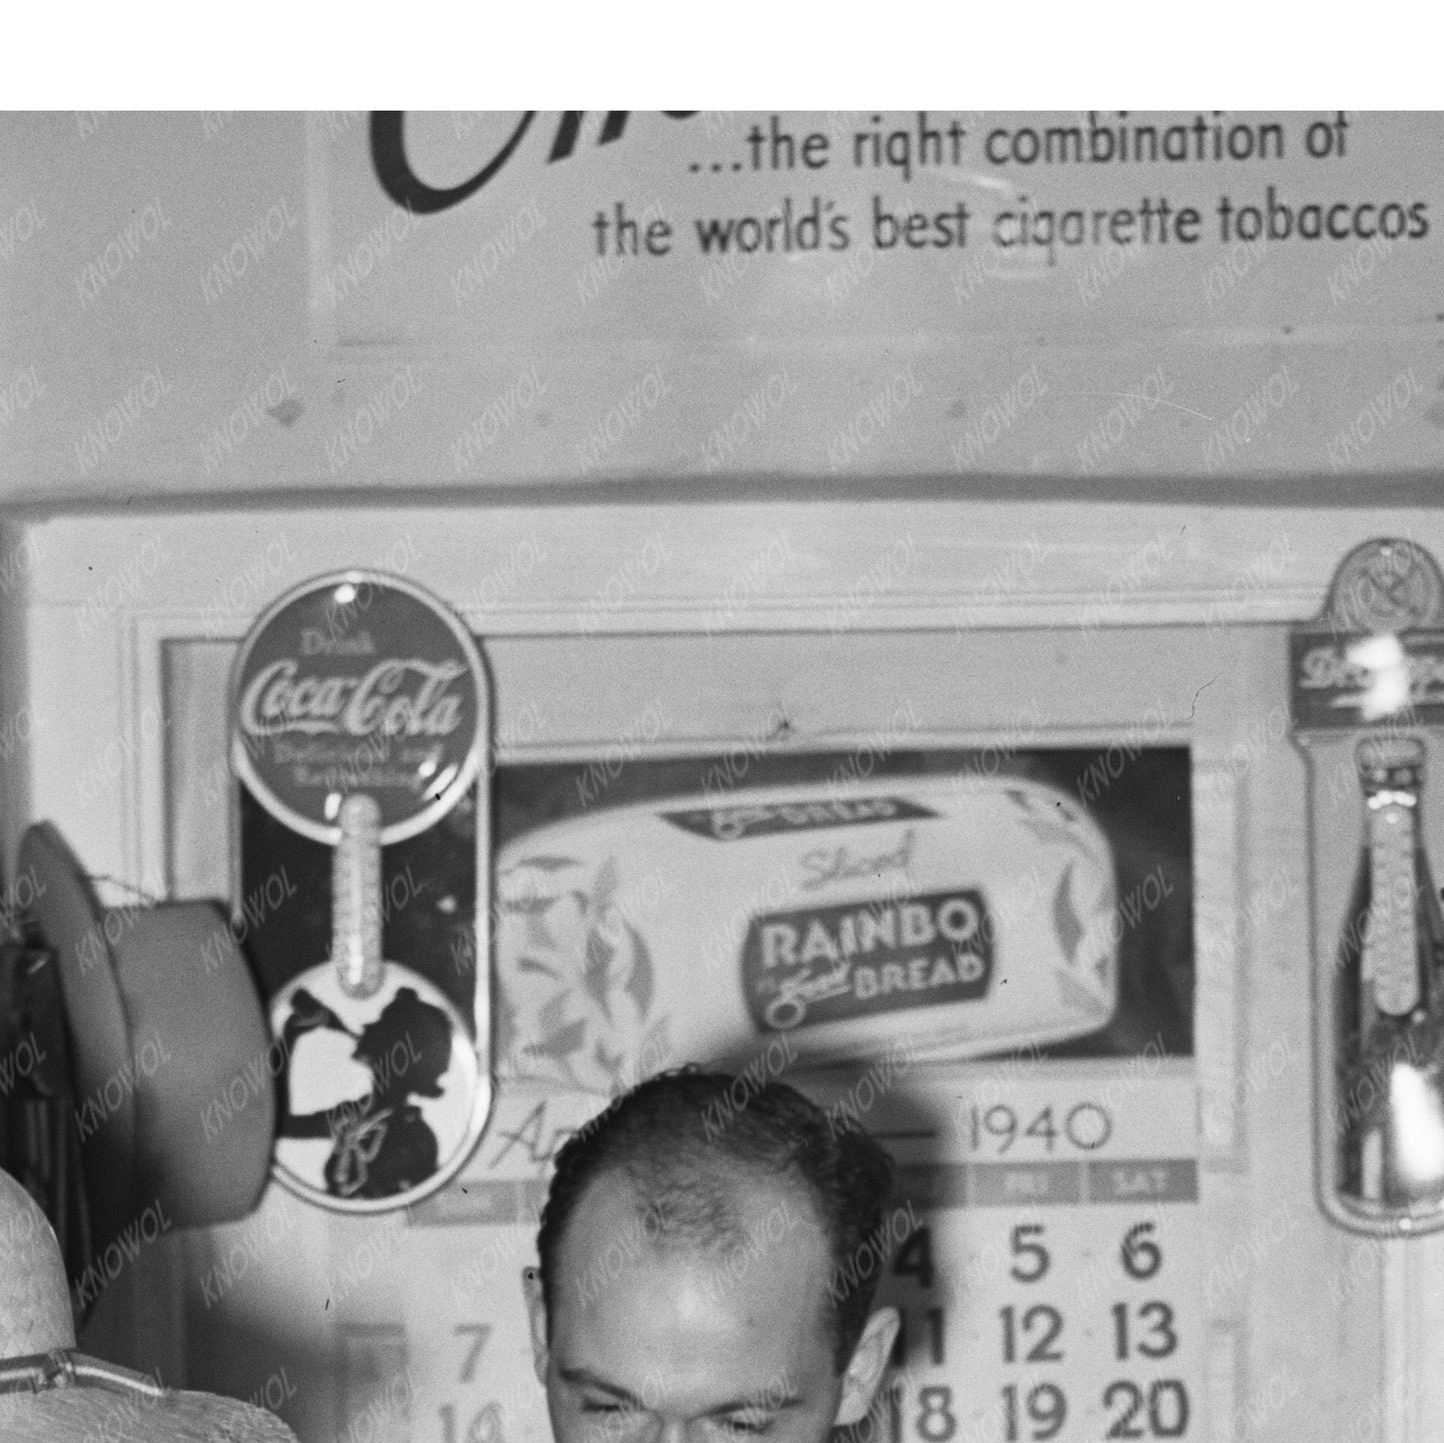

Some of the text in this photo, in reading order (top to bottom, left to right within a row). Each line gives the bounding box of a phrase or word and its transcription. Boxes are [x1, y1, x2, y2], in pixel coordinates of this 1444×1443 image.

[852, 112, 964, 182] right
[984, 111, 1285, 165] combination
[1306, 111, 1349, 159] of
[591, 184, 1430, 268] the world's best cigarette tobaccos
[240, 656, 468, 736] Coca-Cola
[760, 898, 980, 968] RAINBO
[853, 953, 985, 999] BREAD
[970, 1102, 1113, 1156] 1940
[893, 1221, 1163, 1289] 4 5 6
[455, 1324, 492, 1384] 7
[999, 1303, 1064, 1364] 12
[1111, 1301, 1179, 1361] 13
[1102, 1378, 1191, 1441] 20
